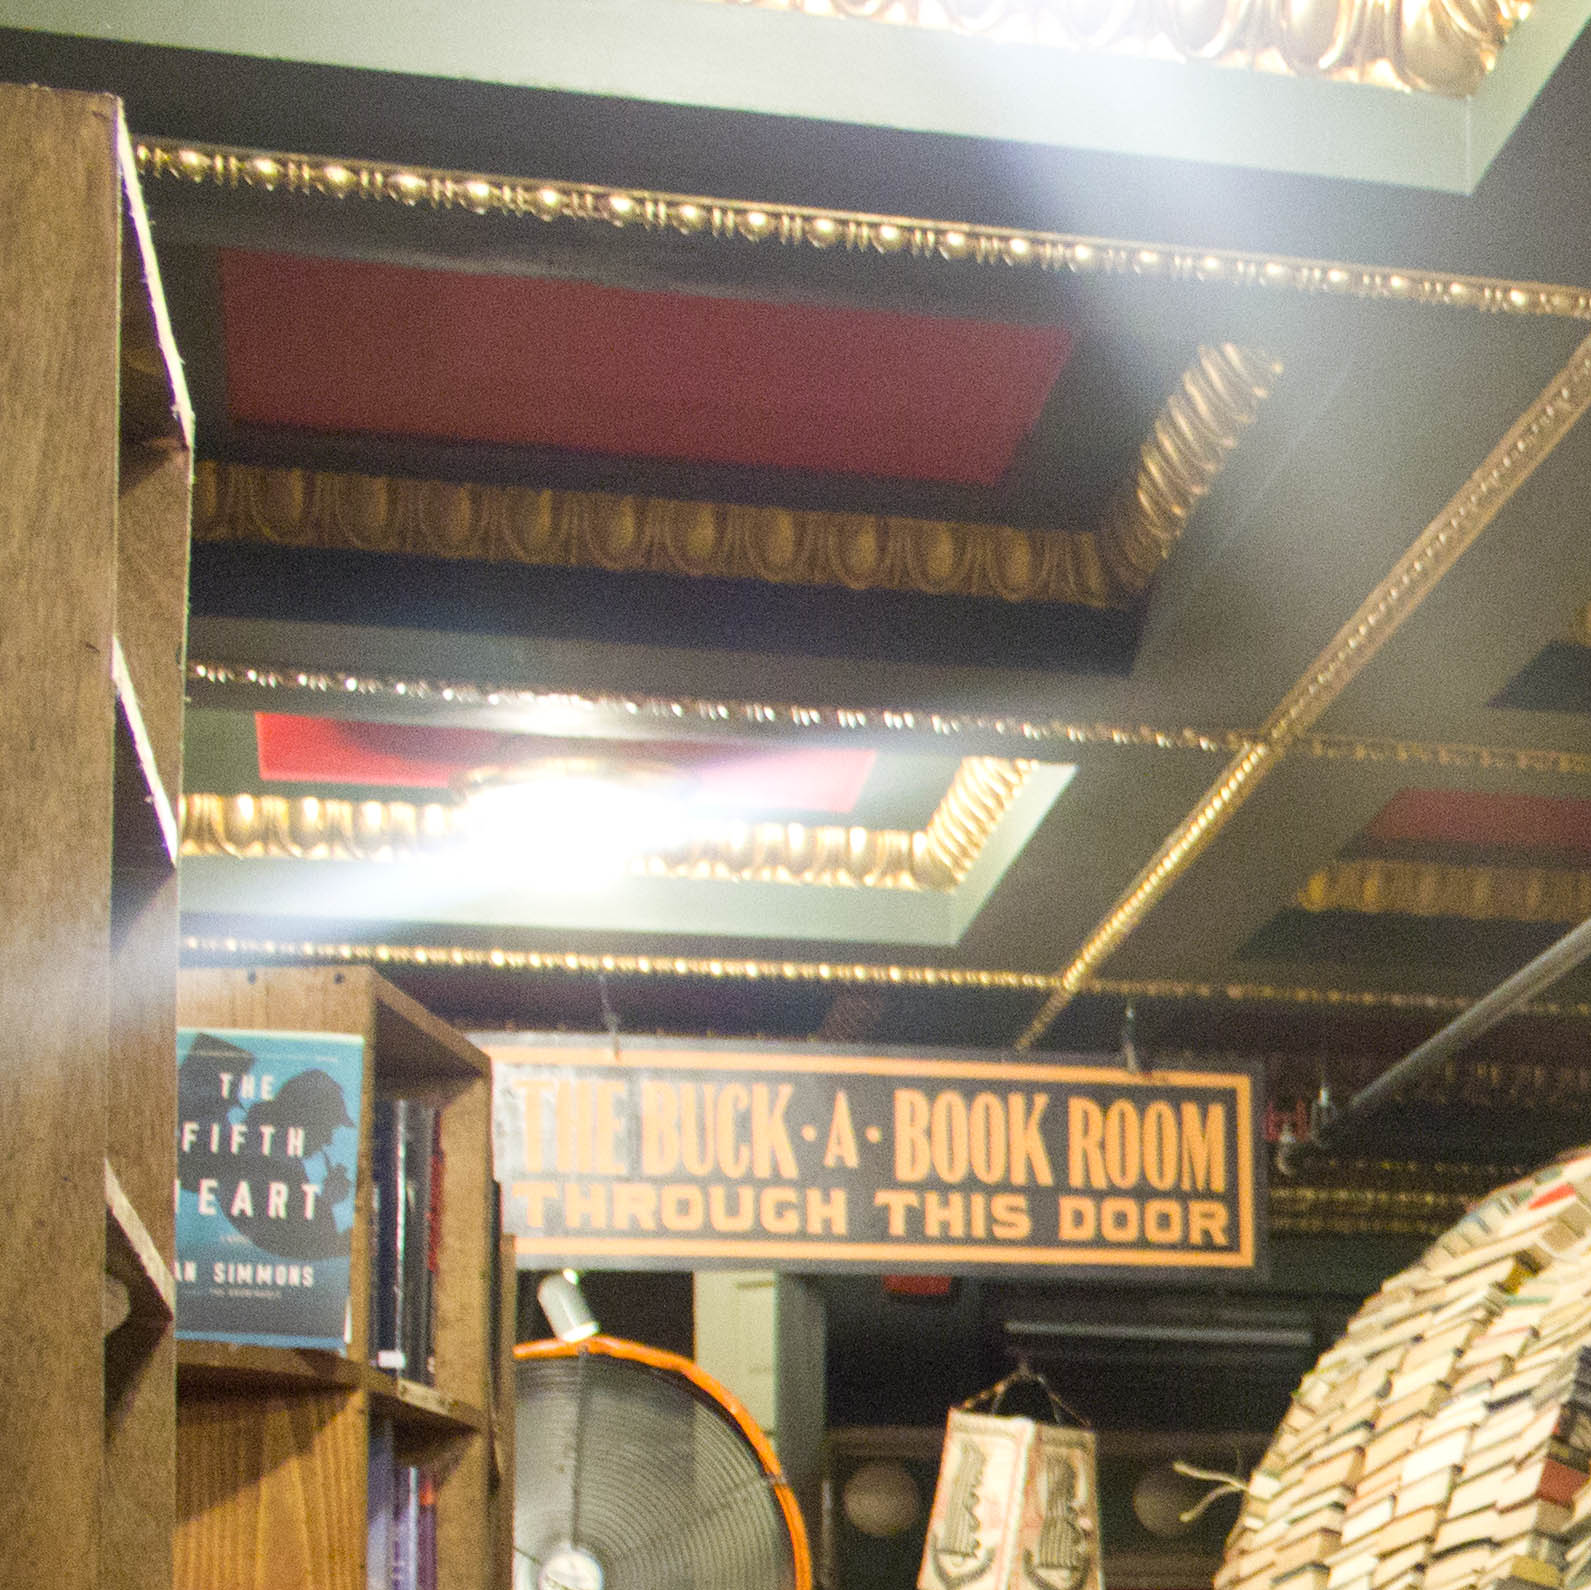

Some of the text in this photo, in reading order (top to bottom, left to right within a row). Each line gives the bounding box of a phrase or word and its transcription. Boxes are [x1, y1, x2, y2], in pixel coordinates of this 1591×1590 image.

[219, 1071, 276, 1102] THE
[180, 1120, 306, 1159] FIFTH
[512, 1078, 627, 1176] THE
[1067, 1096, 1226, 1194] ROOM
[173, 1177, 321, 1221] EART
[511, 1180, 1230, 1247] THROUGH THIS DOOR
[212, 1260, 316, 1289] SIMMONS
